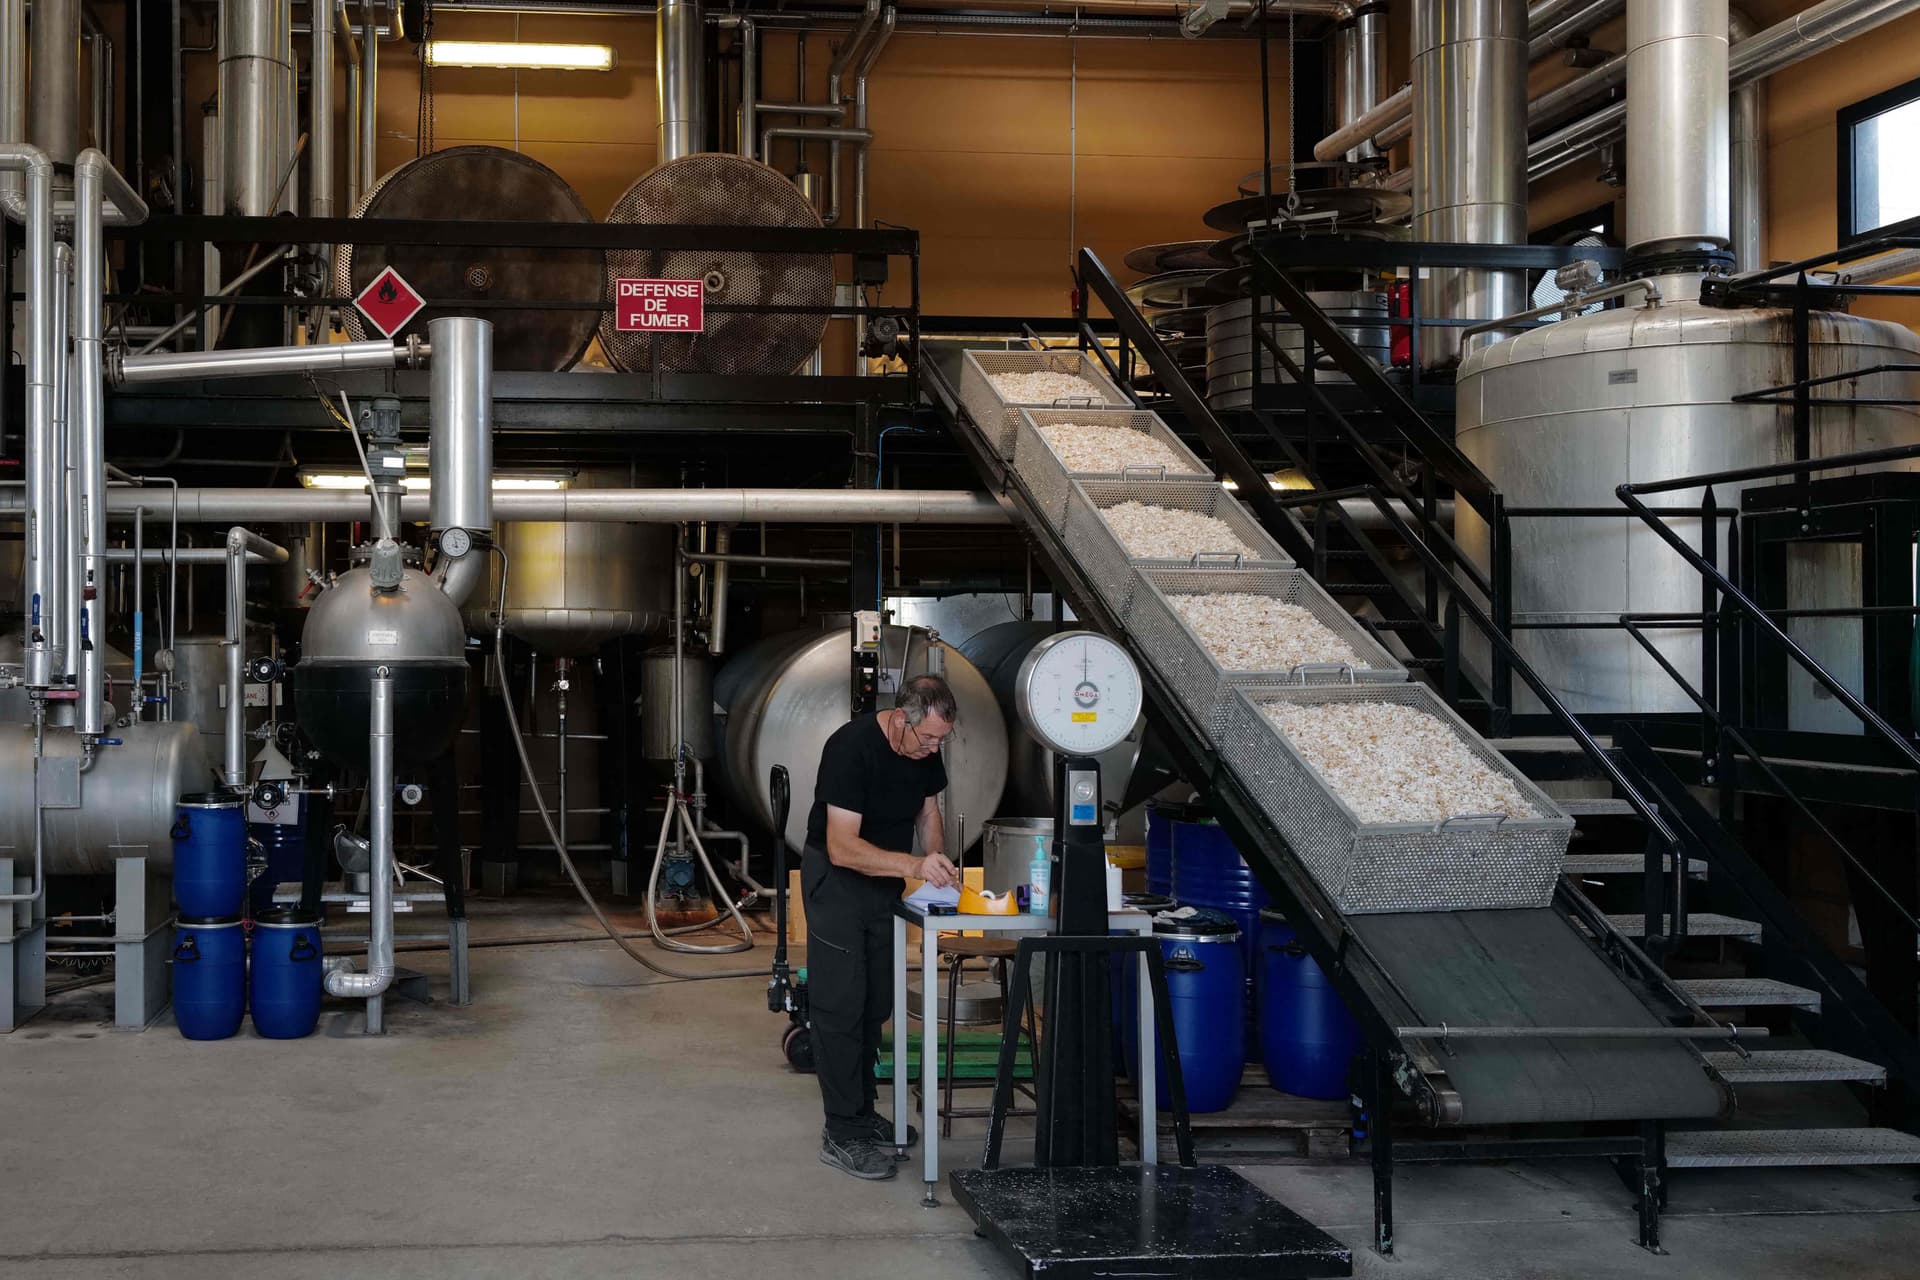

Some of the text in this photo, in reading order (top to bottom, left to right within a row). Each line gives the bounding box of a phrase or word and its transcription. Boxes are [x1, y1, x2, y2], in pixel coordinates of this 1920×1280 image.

[620, 283, 699, 297] DEFENSE
[644, 298, 668, 312] DE
[630, 313, 689, 327] FUMER
